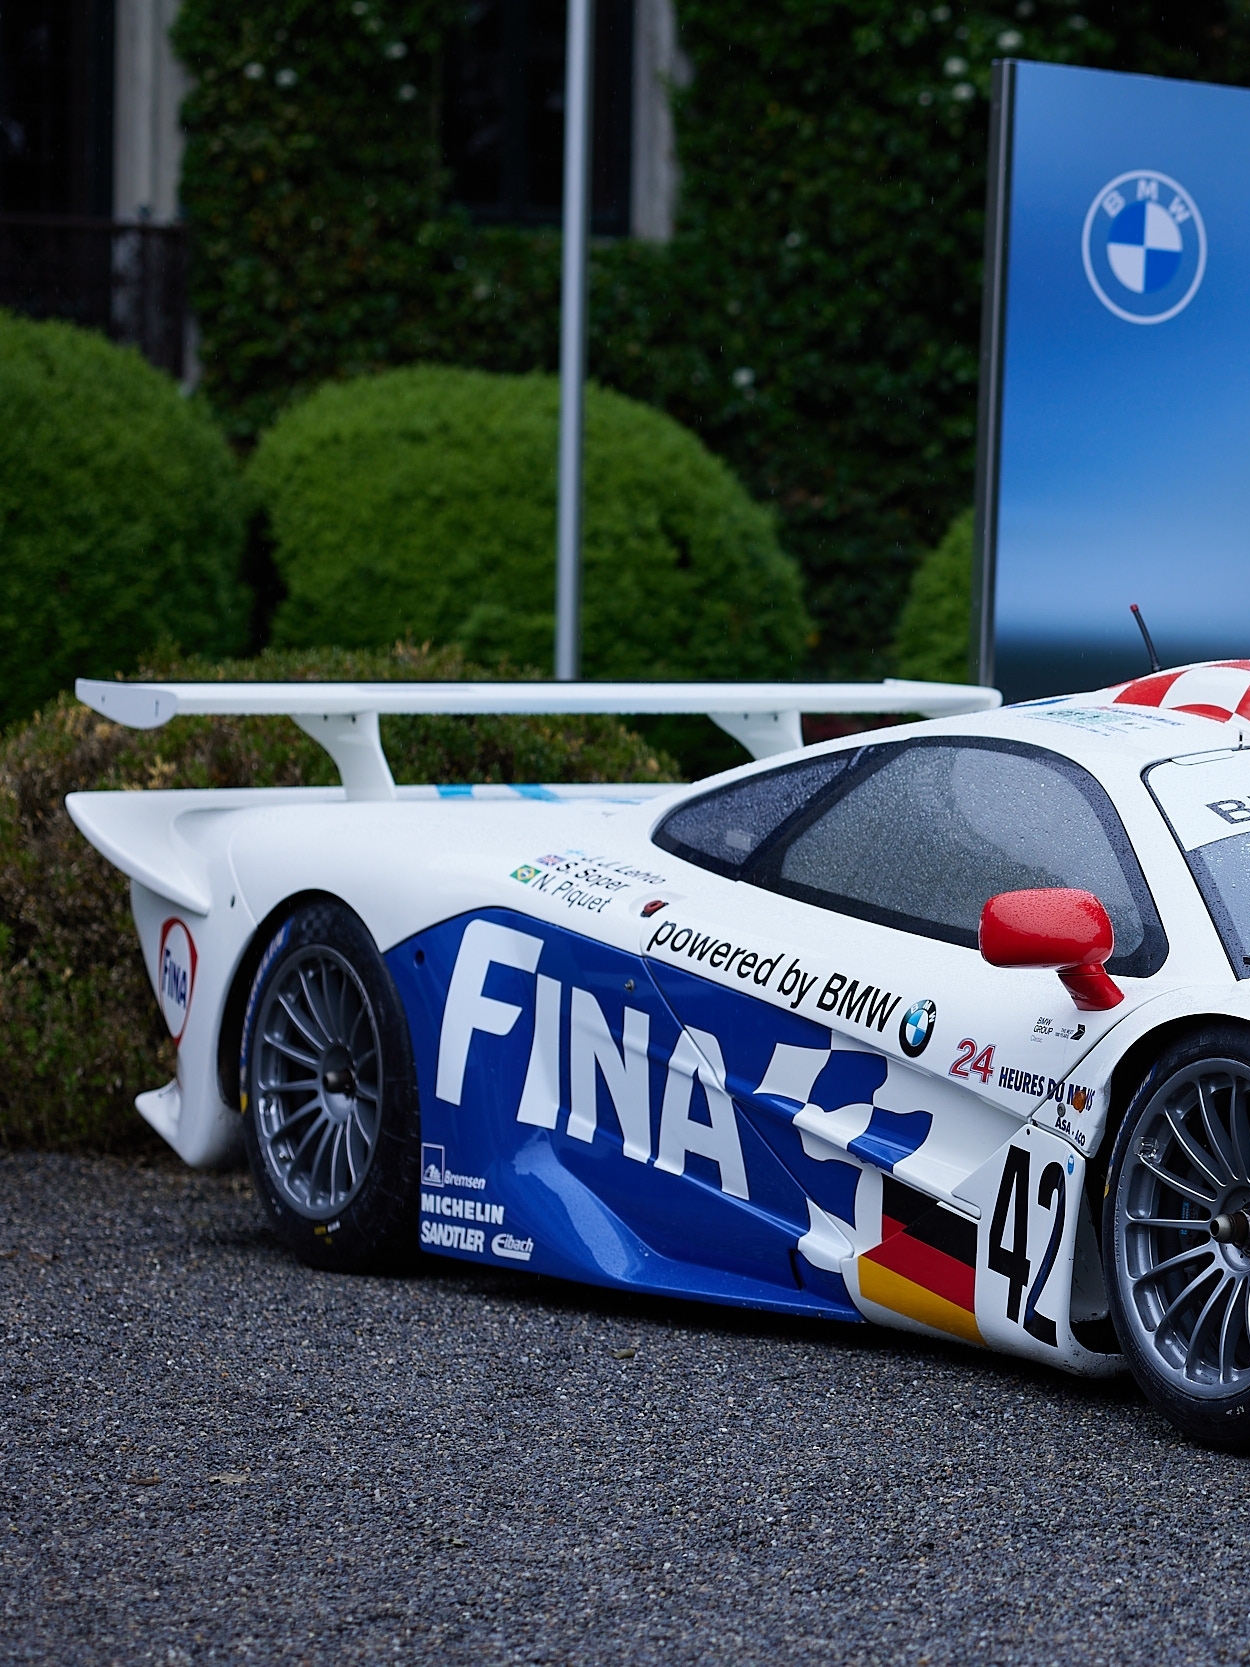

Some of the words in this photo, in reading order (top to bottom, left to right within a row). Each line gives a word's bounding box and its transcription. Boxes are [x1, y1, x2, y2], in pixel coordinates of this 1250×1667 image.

[1102, 178, 1192, 224] BMW
[552, 880, 613, 913] Piquet
[574, 867, 631, 892] Soper
[647, 920, 785, 987] powered
[777, 958, 818, 1008] by
[816, 972, 902, 1033] BMW
[910, 1000, 936, 1023] BMW
[435, 918, 750, 1201] FINA
[948, 1037, 997, 1085] 24
[998, 1066, 1046, 1097] HEURES
[1047, 1077, 1066, 1103] DU
[1055, 1116, 1071, 1135] ASA
[444, 1169, 486, 1190] Bremsen
[420, 1192, 505, 1225] MICHELIN
[420, 1220, 485, 1253] SANDTLER
[491, 1233, 534, 1261] Eibach
[987, 1144, 1066, 1348] 42
